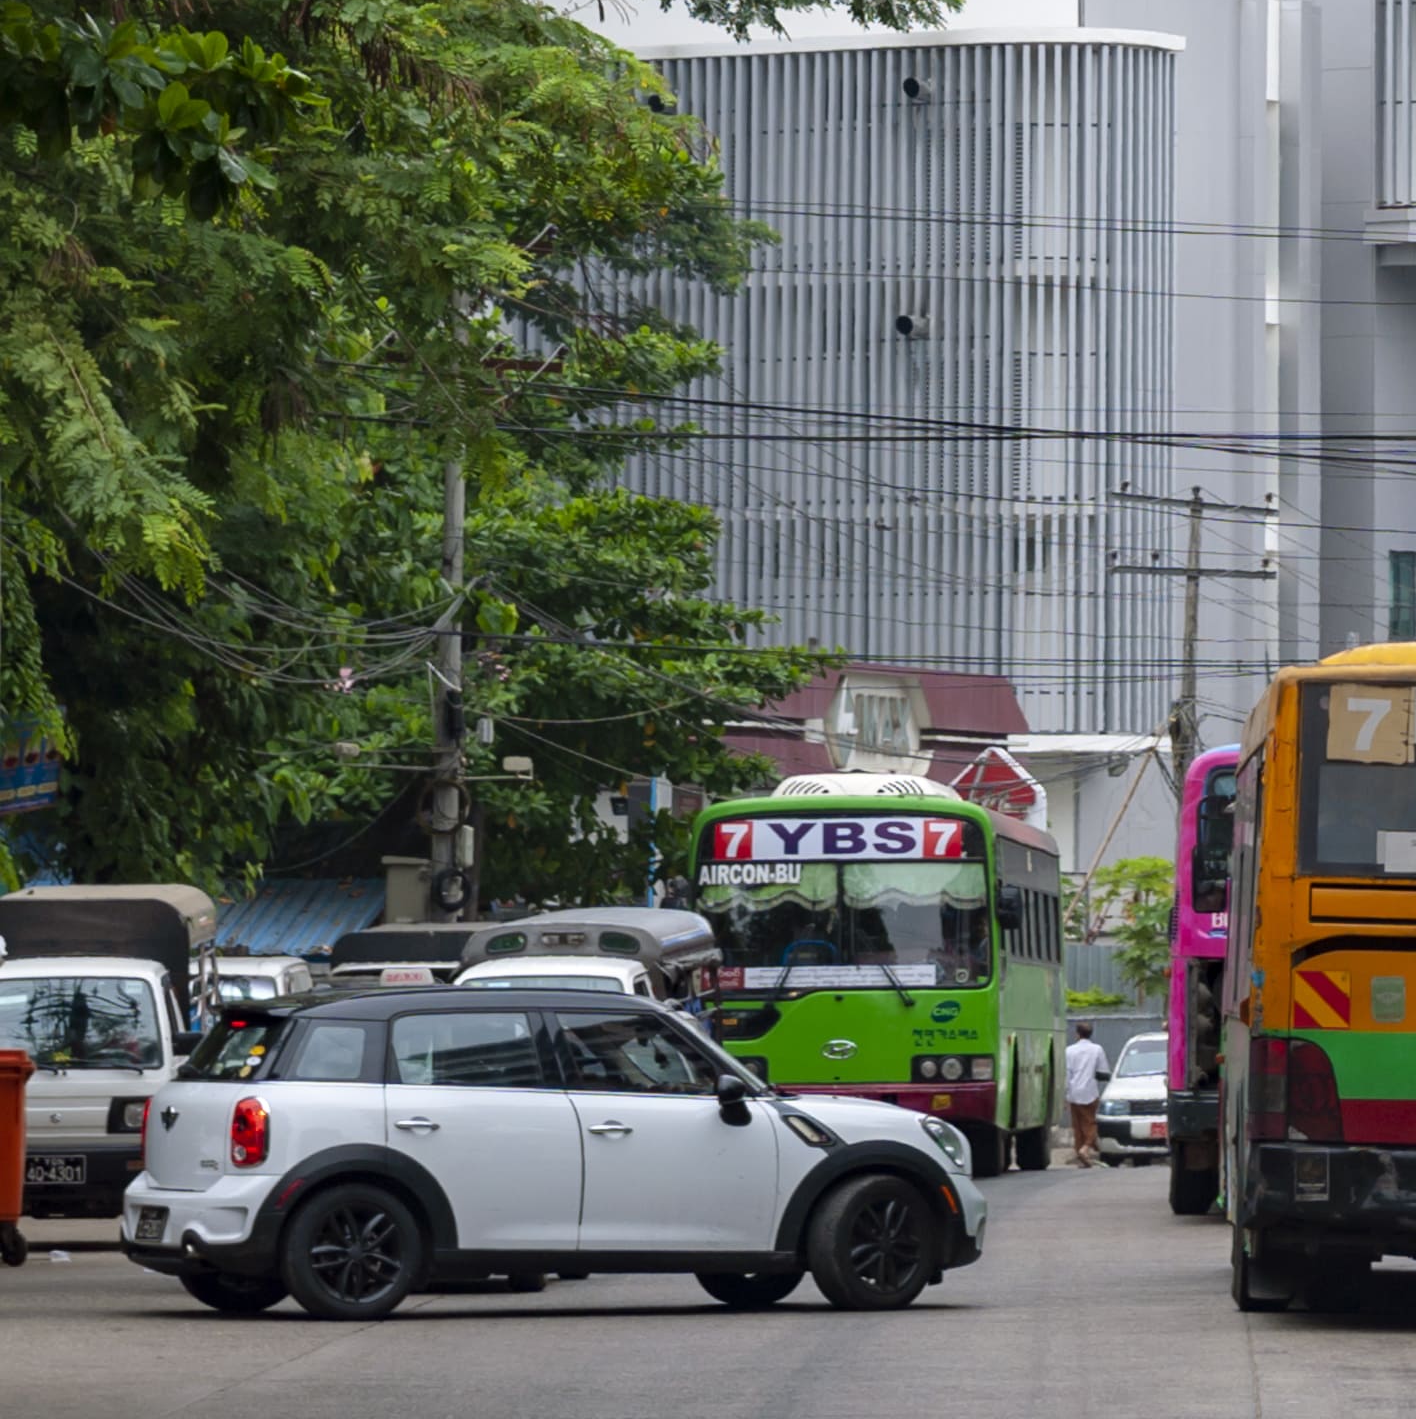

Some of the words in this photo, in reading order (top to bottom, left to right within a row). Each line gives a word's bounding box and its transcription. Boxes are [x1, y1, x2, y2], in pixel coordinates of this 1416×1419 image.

[1346, 696, 1393, 752] 7
[719, 823, 749, 858] 7
[767, 821, 917, 855] YBS
[928, 822, 958, 856] 7
